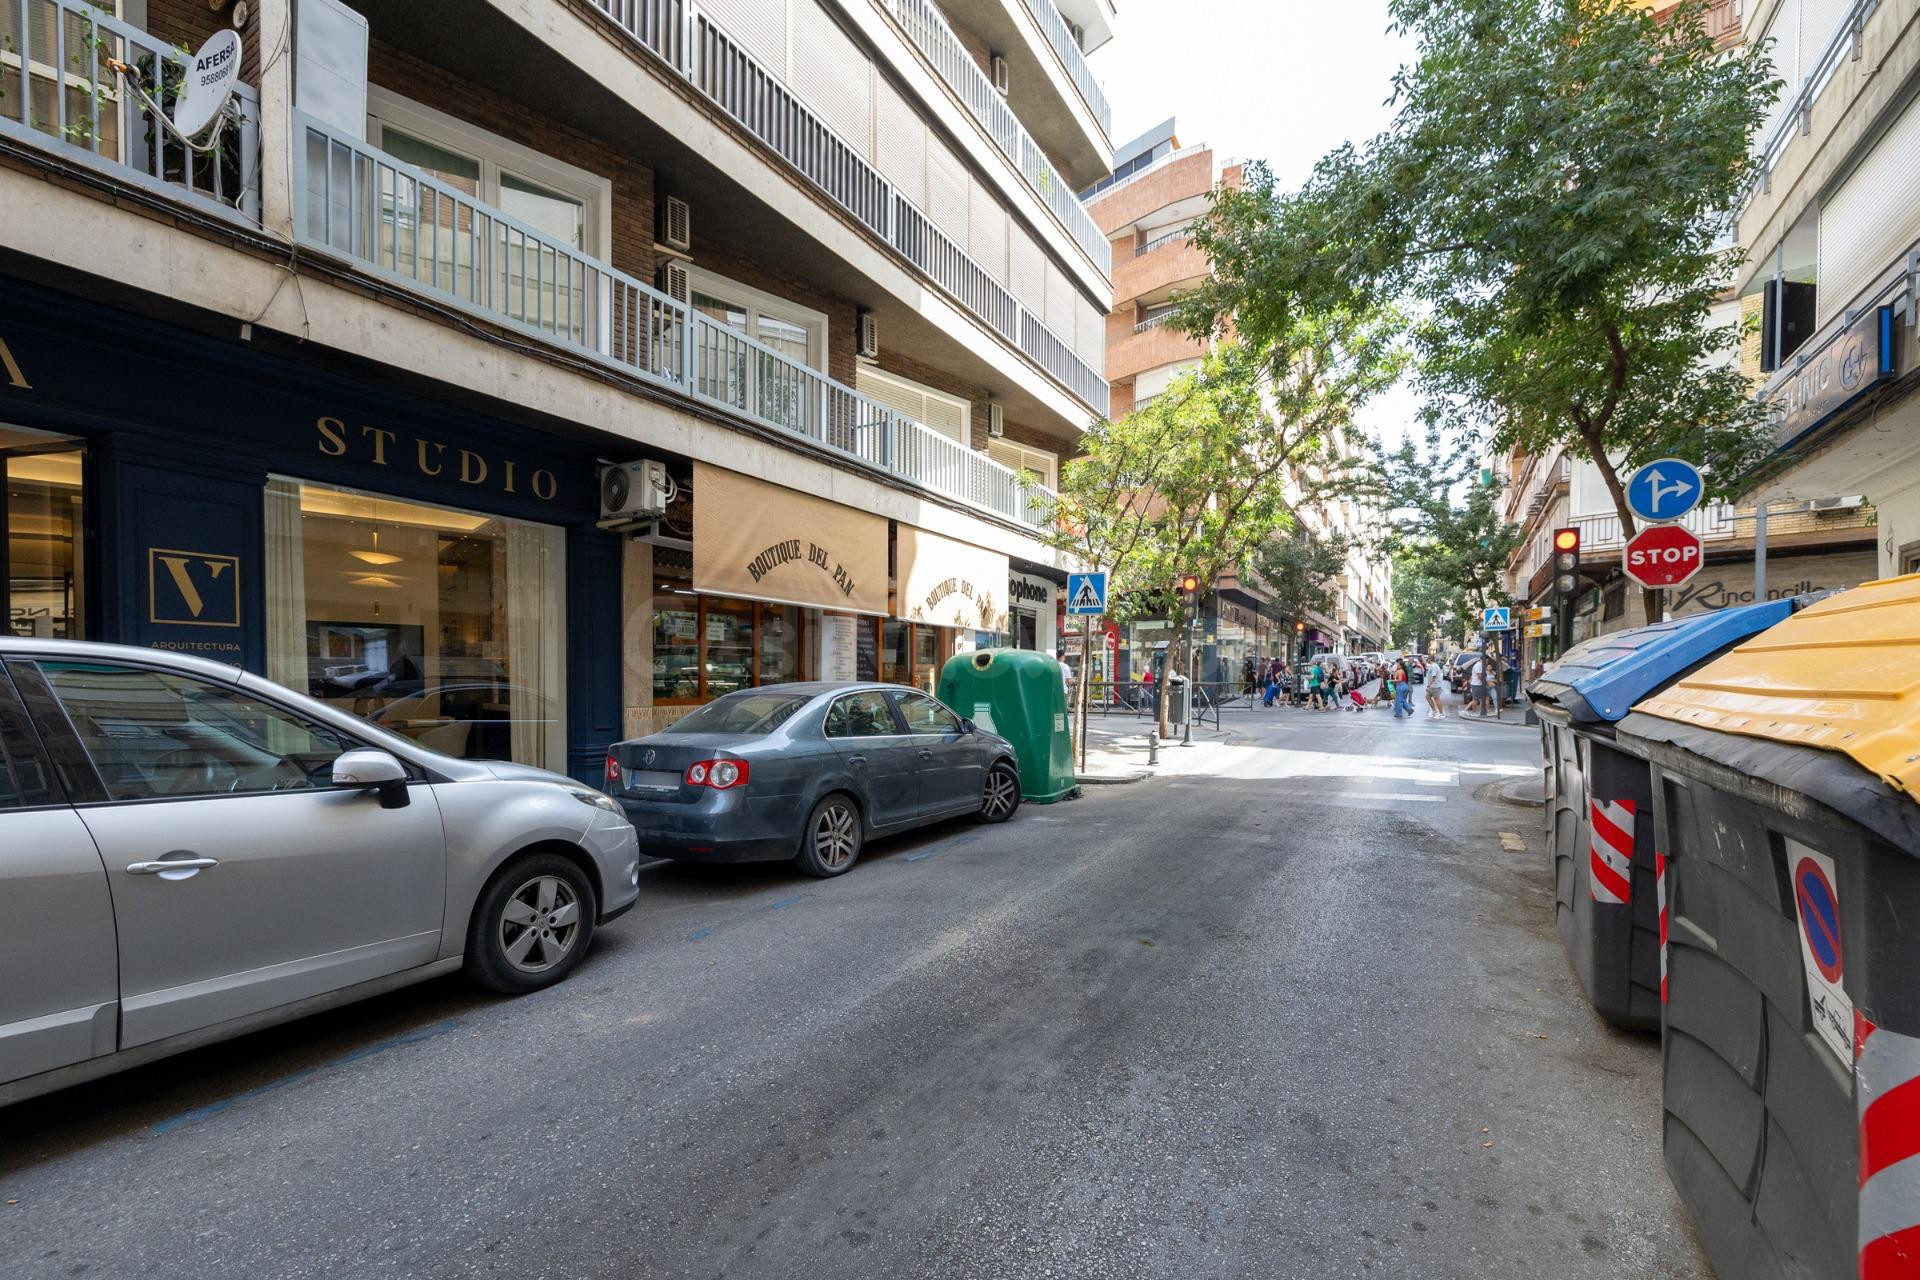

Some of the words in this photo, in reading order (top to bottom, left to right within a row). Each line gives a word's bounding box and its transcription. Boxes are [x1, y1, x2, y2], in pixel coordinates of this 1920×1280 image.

[196, 40, 235, 72] AFERSA
[316, 416, 558, 500] STUDIO
[746, 539, 802, 584] BOUTIQUE
[808, 542, 829, 571] DEL
[832, 562, 855, 598] PAN
[1630, 546, 1698, 567] STOP
[925, 577, 958, 612] BOUTIQUE
[961, 579, 974, 601] DEL
[1672, 580, 1826, 611] Rincncill
[151, 641, 241, 651] ARQUITECTURA
